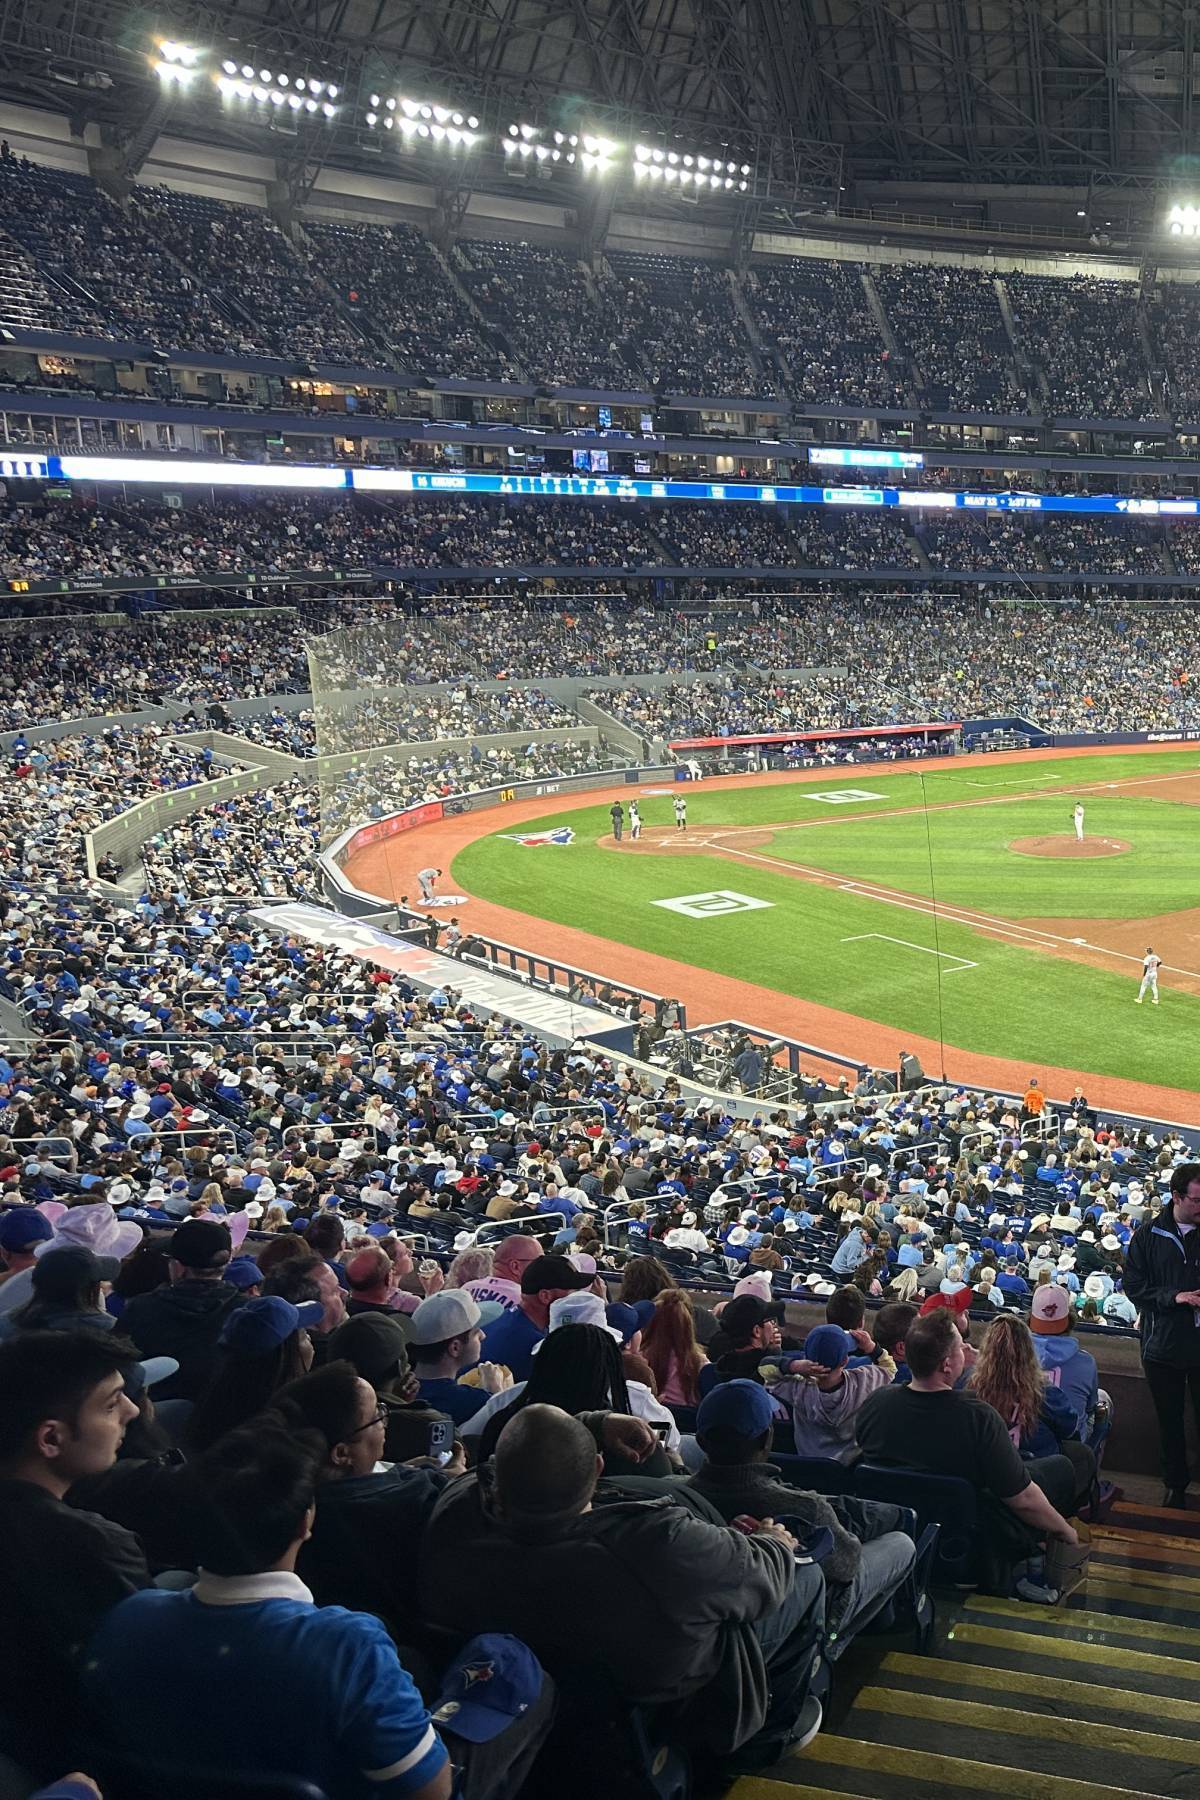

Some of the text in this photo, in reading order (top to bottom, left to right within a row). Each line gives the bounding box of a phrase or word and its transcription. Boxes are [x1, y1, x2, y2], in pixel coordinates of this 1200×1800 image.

[1187, 731, 1200, 739] BET
[546, 784, 560, 793] BET
[680, 894, 750, 912] TD
